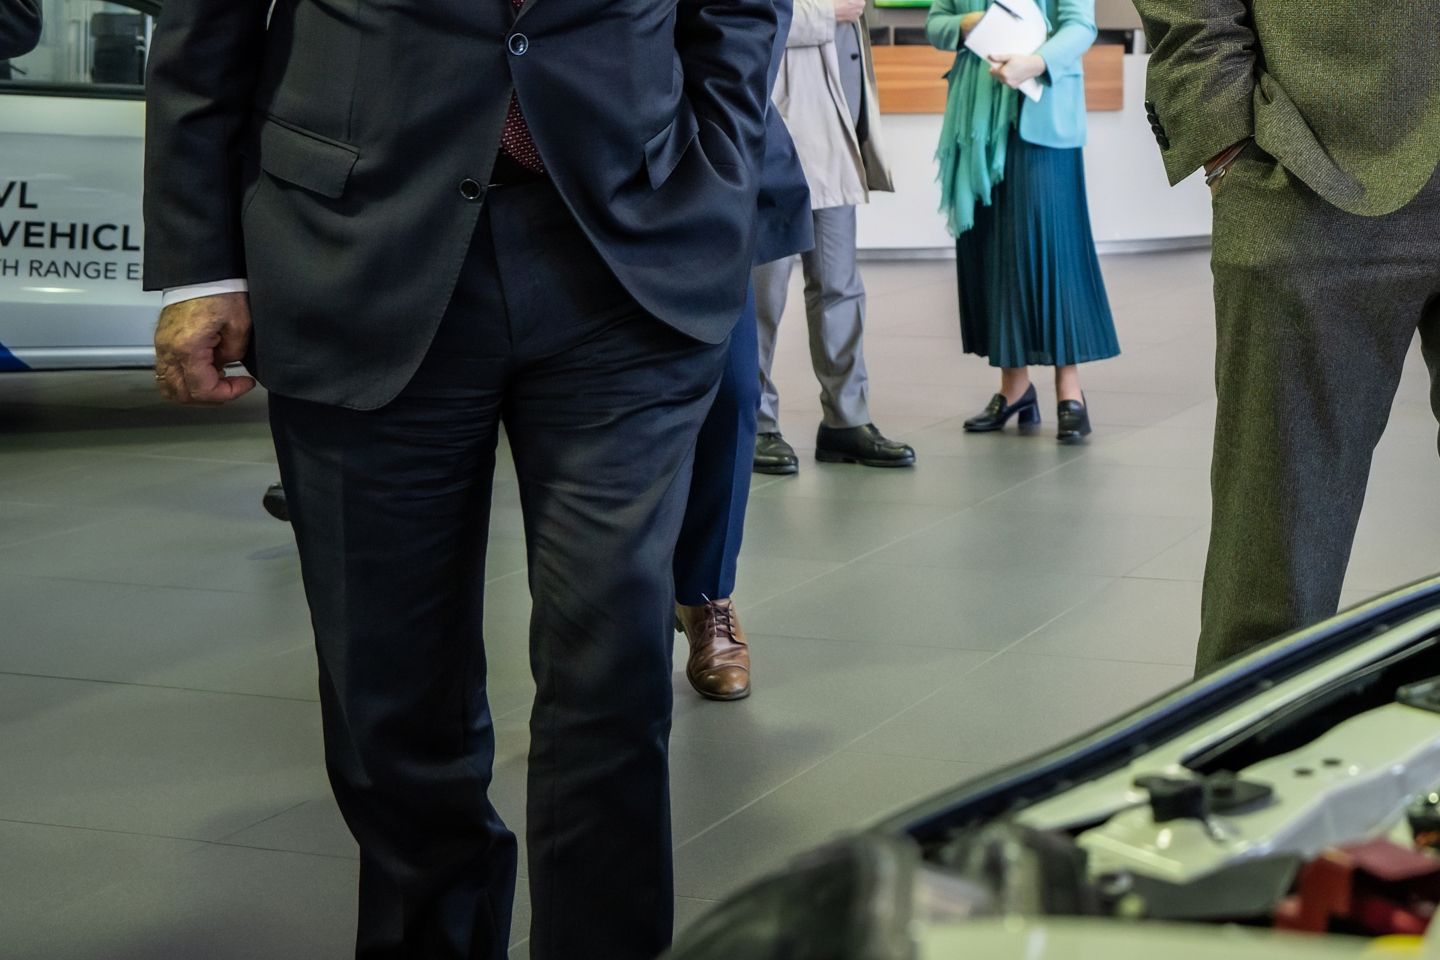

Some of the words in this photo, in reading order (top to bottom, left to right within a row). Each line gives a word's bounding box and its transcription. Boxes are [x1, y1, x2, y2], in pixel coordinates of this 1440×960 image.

[0, 220, 140, 251] VEHICL
[0, 259, 19, 276] H
[29, 259, 117, 280] RANGE
[127, 263, 143, 280] E
